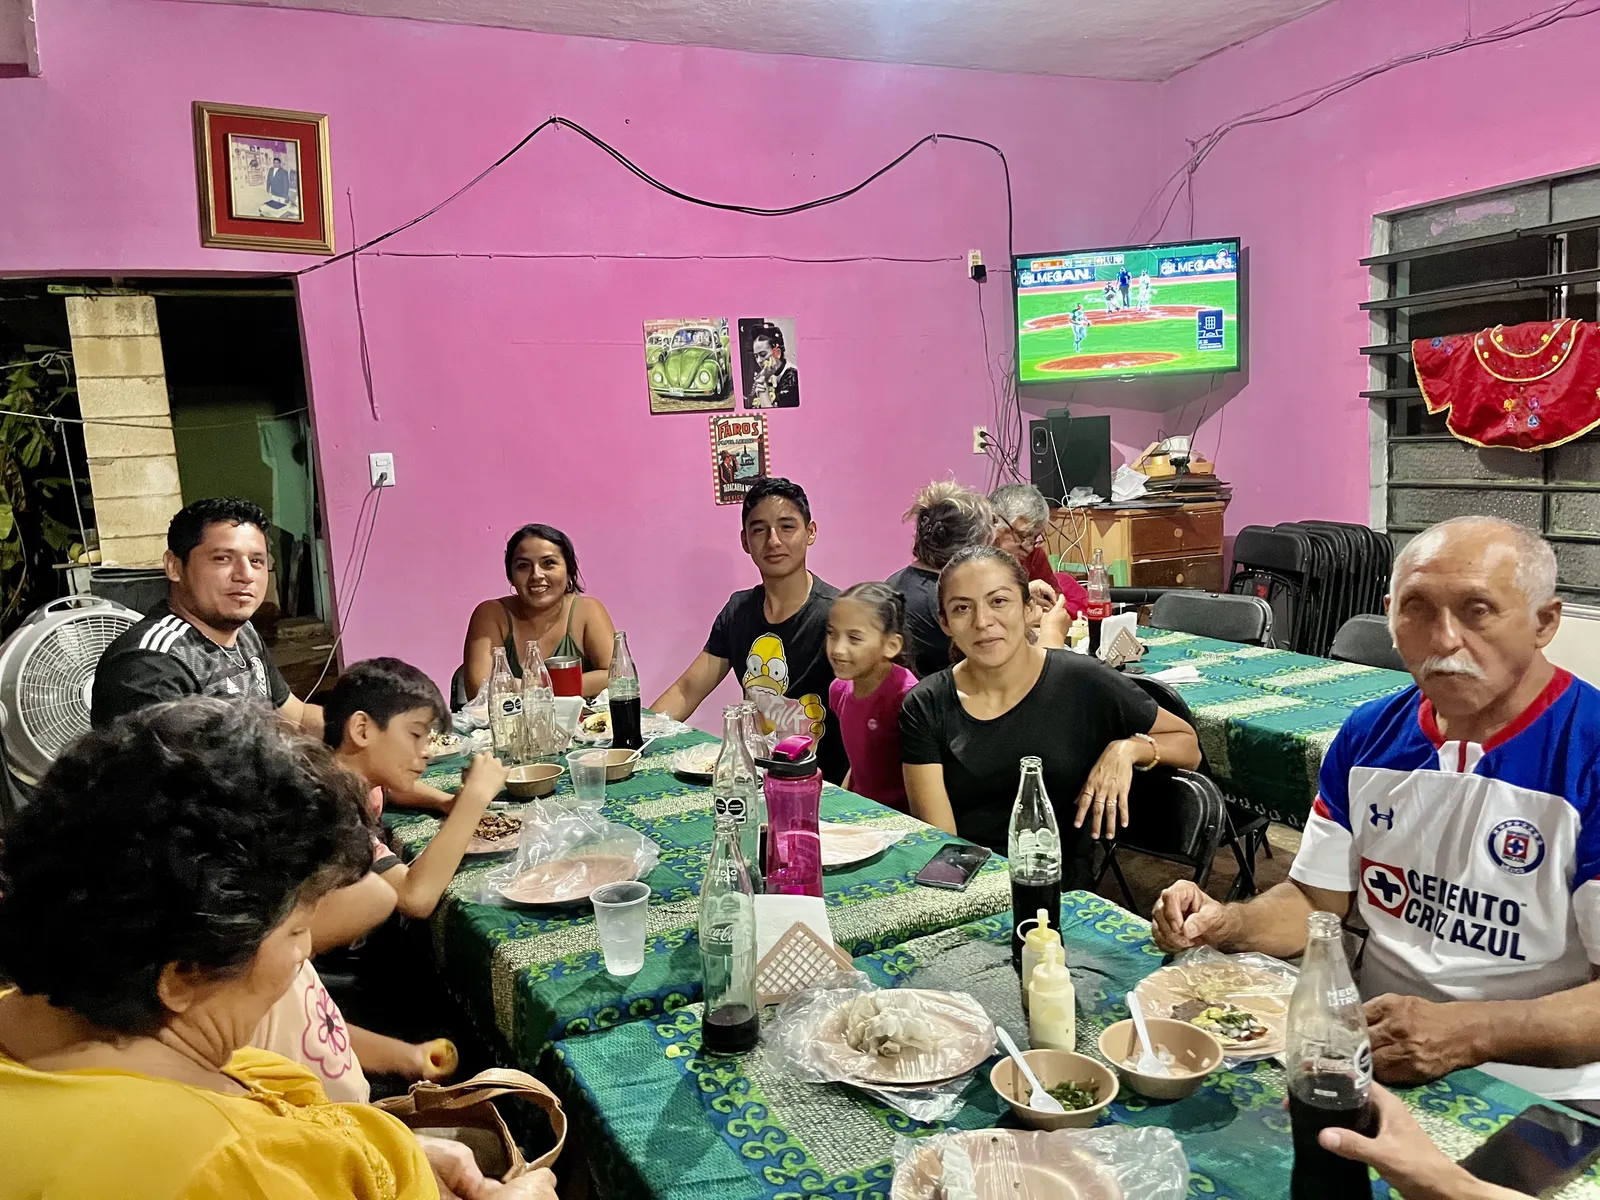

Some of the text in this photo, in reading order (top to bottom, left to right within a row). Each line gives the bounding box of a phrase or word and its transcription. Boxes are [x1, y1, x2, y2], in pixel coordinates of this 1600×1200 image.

[717, 420, 759, 440] FAROS
[1405, 898, 1526, 961] CRZ AZUL
